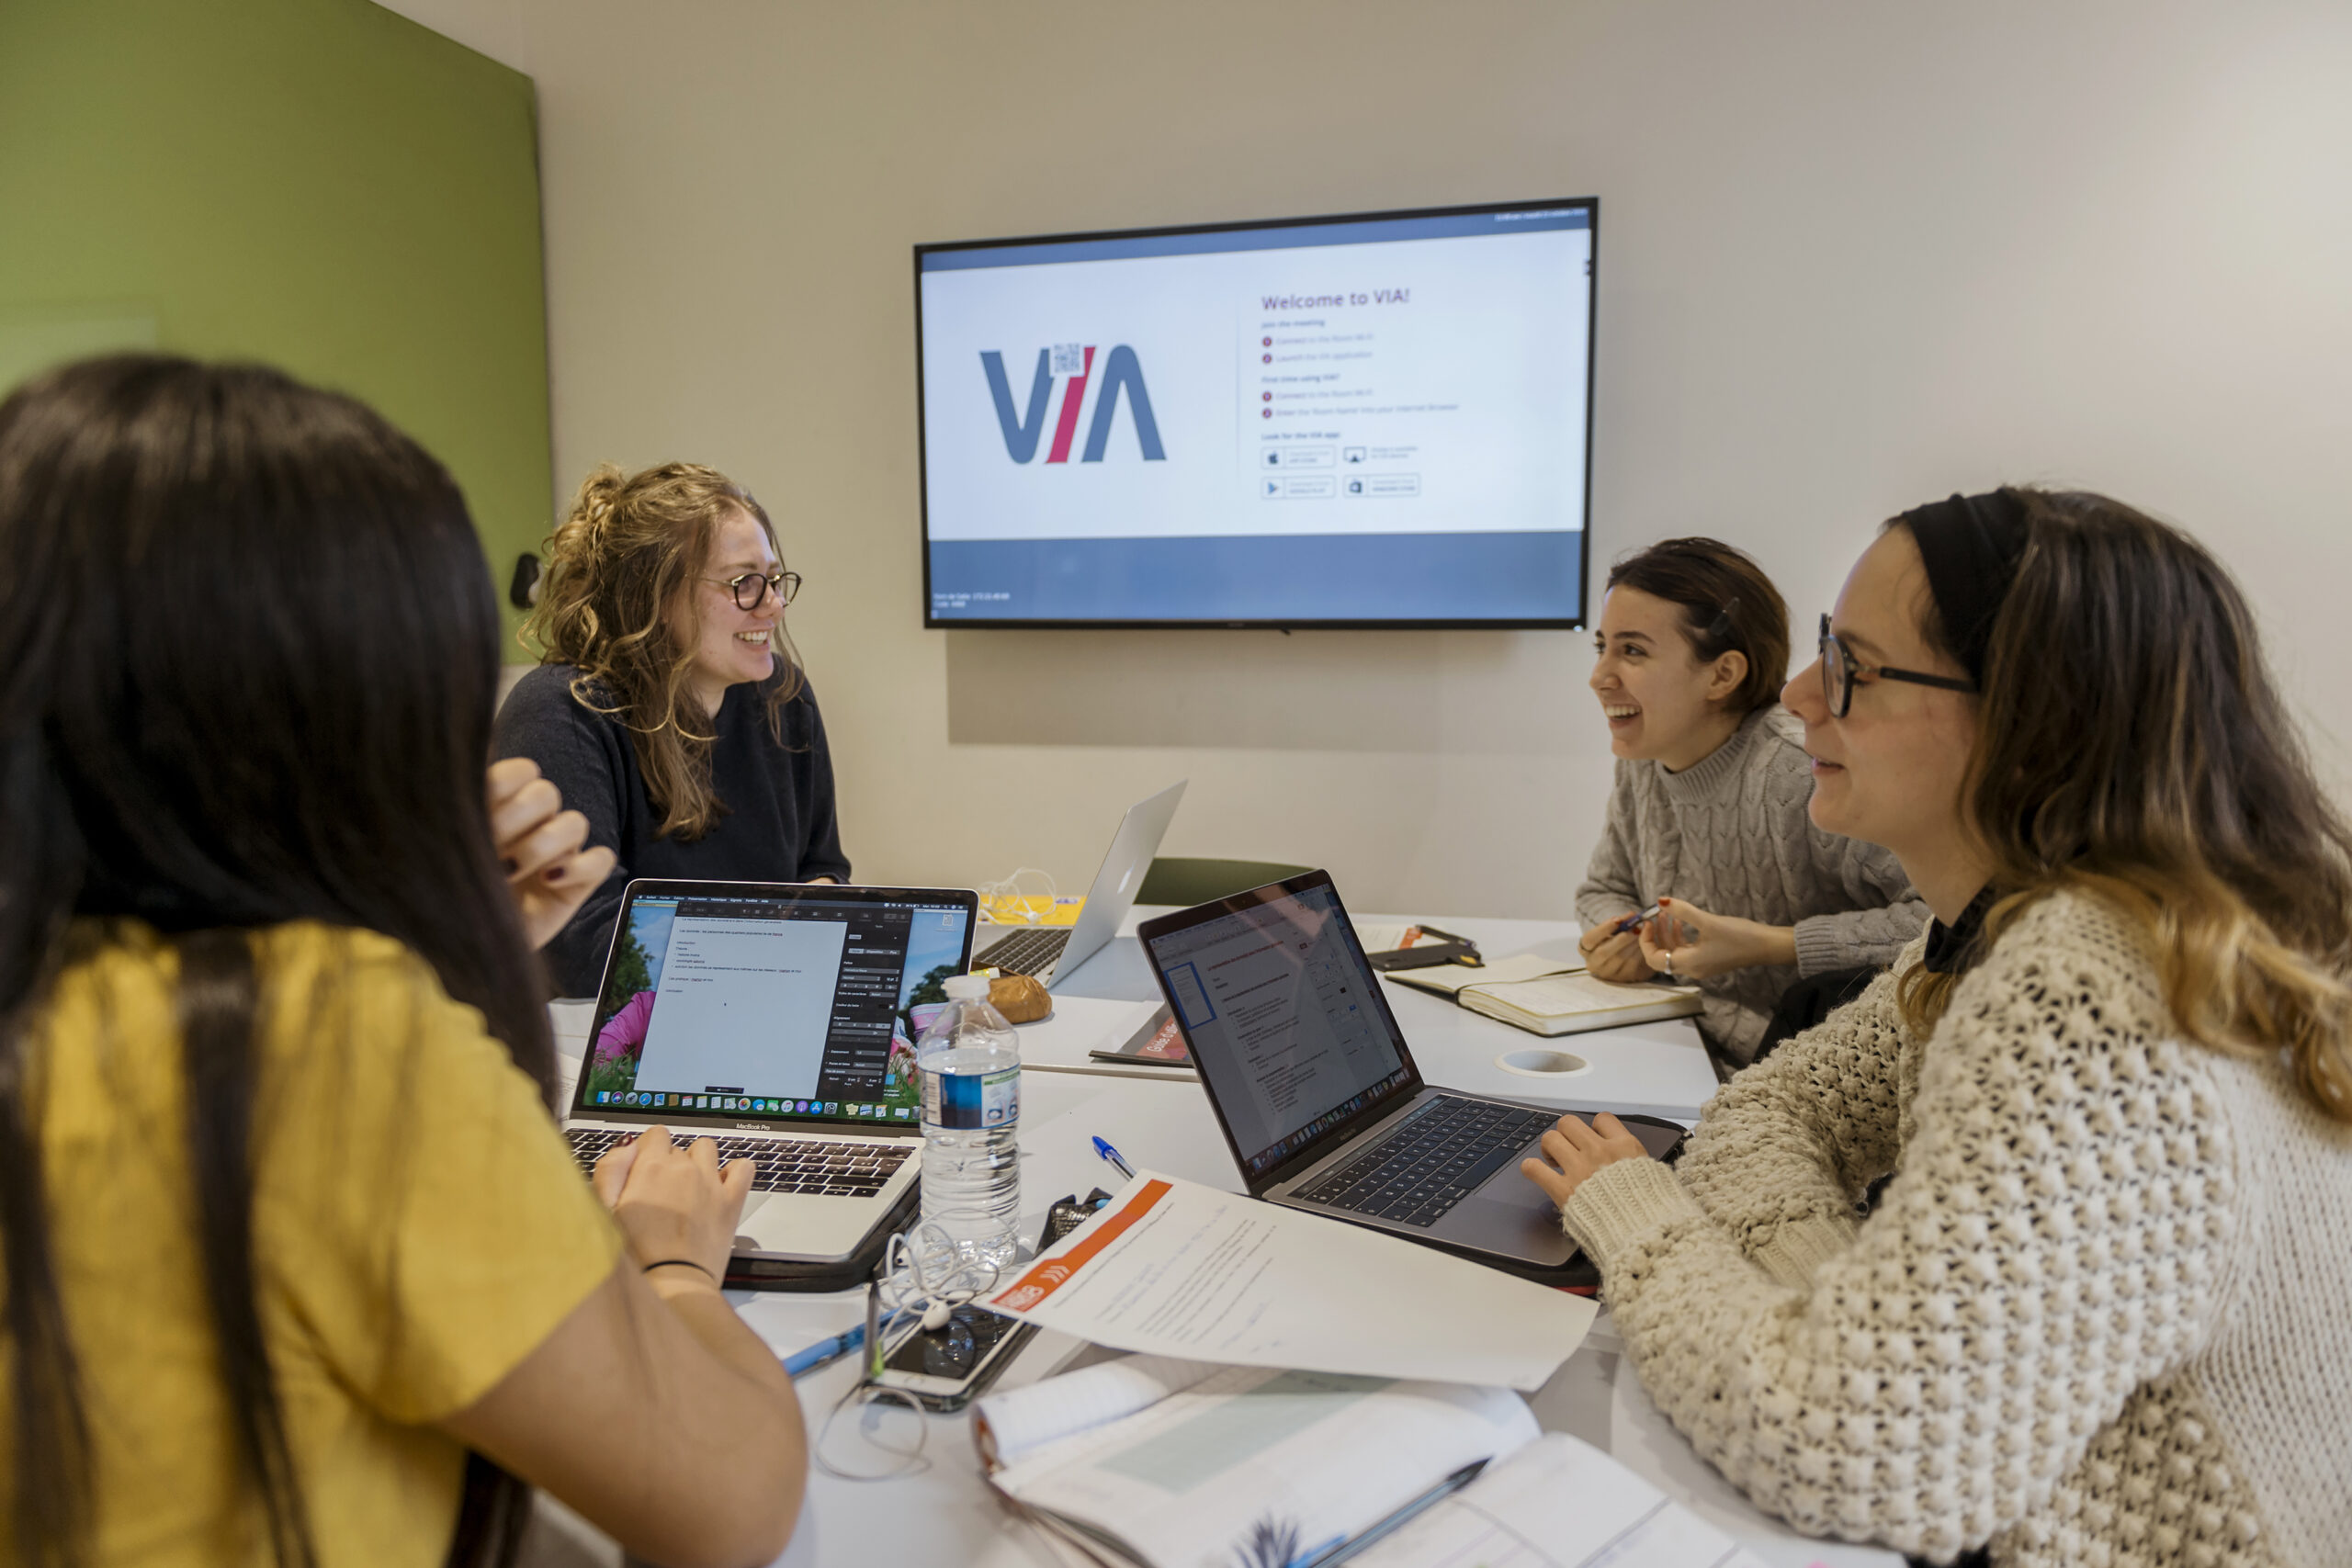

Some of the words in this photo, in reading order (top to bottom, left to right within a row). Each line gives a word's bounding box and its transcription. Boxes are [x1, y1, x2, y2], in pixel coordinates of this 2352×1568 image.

[1261, 293, 1344, 311] Welcome
[1350, 291, 1369, 306] to
[1373, 288, 1410, 304] VIA!
[979, 344, 1167, 464] VIA
